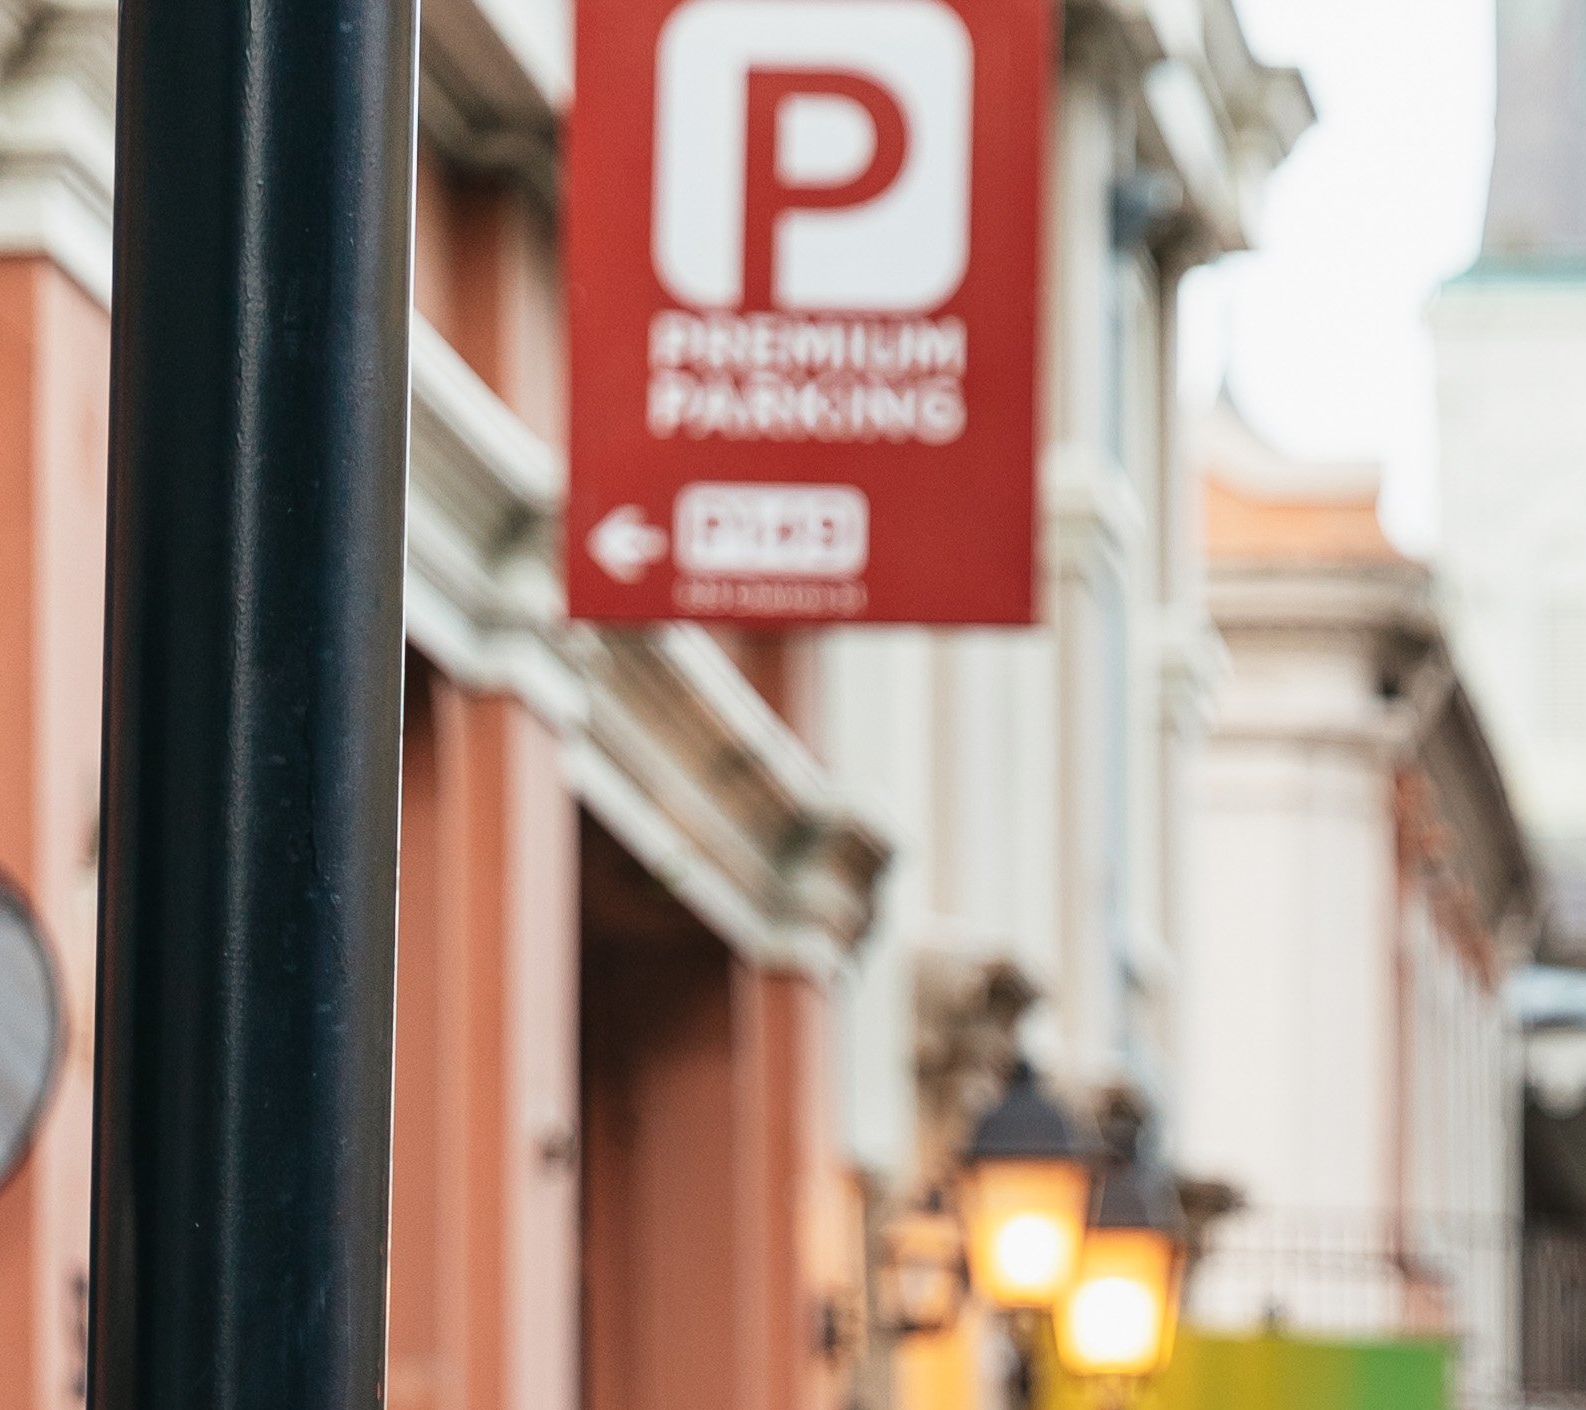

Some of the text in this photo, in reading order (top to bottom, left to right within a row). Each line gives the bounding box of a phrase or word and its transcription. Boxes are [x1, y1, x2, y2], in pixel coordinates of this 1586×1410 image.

[742, 65, 912, 310] P
[651, 313, 966, 374] PREMIUM
[650, 377, 966, 438] PARKING
